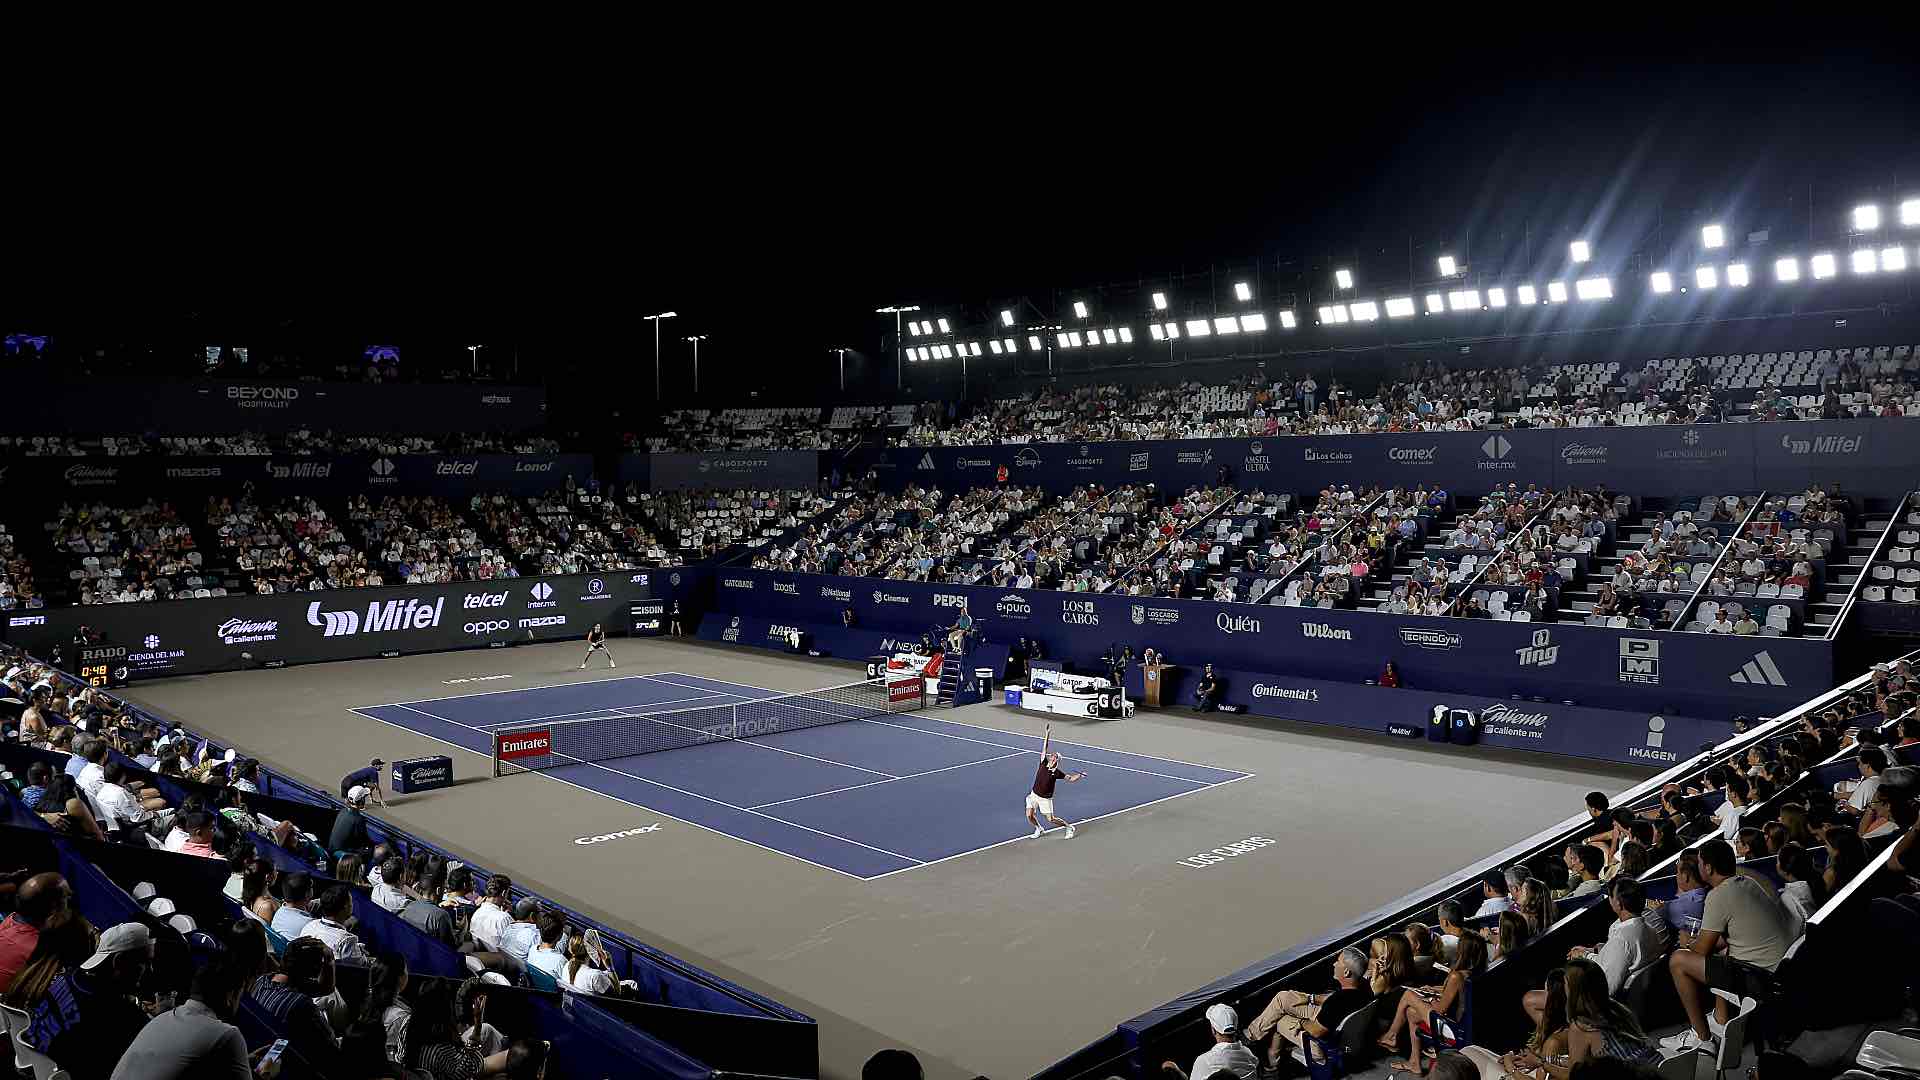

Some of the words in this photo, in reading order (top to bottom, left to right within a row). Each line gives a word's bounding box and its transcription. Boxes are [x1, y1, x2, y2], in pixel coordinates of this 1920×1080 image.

[227, 386, 298, 400] BEYOND
[1812, 436, 1861, 453] Mifel
[1245, 456, 1271, 464] AMSTEL
[1388, 446, 1437, 460] Comex
[292, 462, 332, 478] Mifel
[436, 460, 479, 475] telcel
[1245, 464, 1270, 472] ULTRA
[463, 591, 509, 609] telcel
[933, 593, 967, 608] PEPSI
[1063, 601, 1084, 612] LOS
[9, 616, 45, 627] ESPN
[363, 596, 444, 633] Mifel
[518, 615, 566, 628] mazda
[1062, 613, 1098, 625] CABOS
[463, 619, 510, 636] oppo
[1216, 612, 1260, 633] Quién
[1302, 622, 1352, 640] Wilson
[81, 647, 127, 660] RADO
[82, 664, 107, 677] 0:48
[90, 675, 107, 686] 167
[1252, 683, 1309, 700] Continental
[502, 736, 548, 753] Emirates
[1628, 747, 1677, 762] IMAGEN
[574, 822, 663, 845] Comex
[1176, 852, 1225, 869] LOS
[1211, 836, 1276, 857] CABOS
